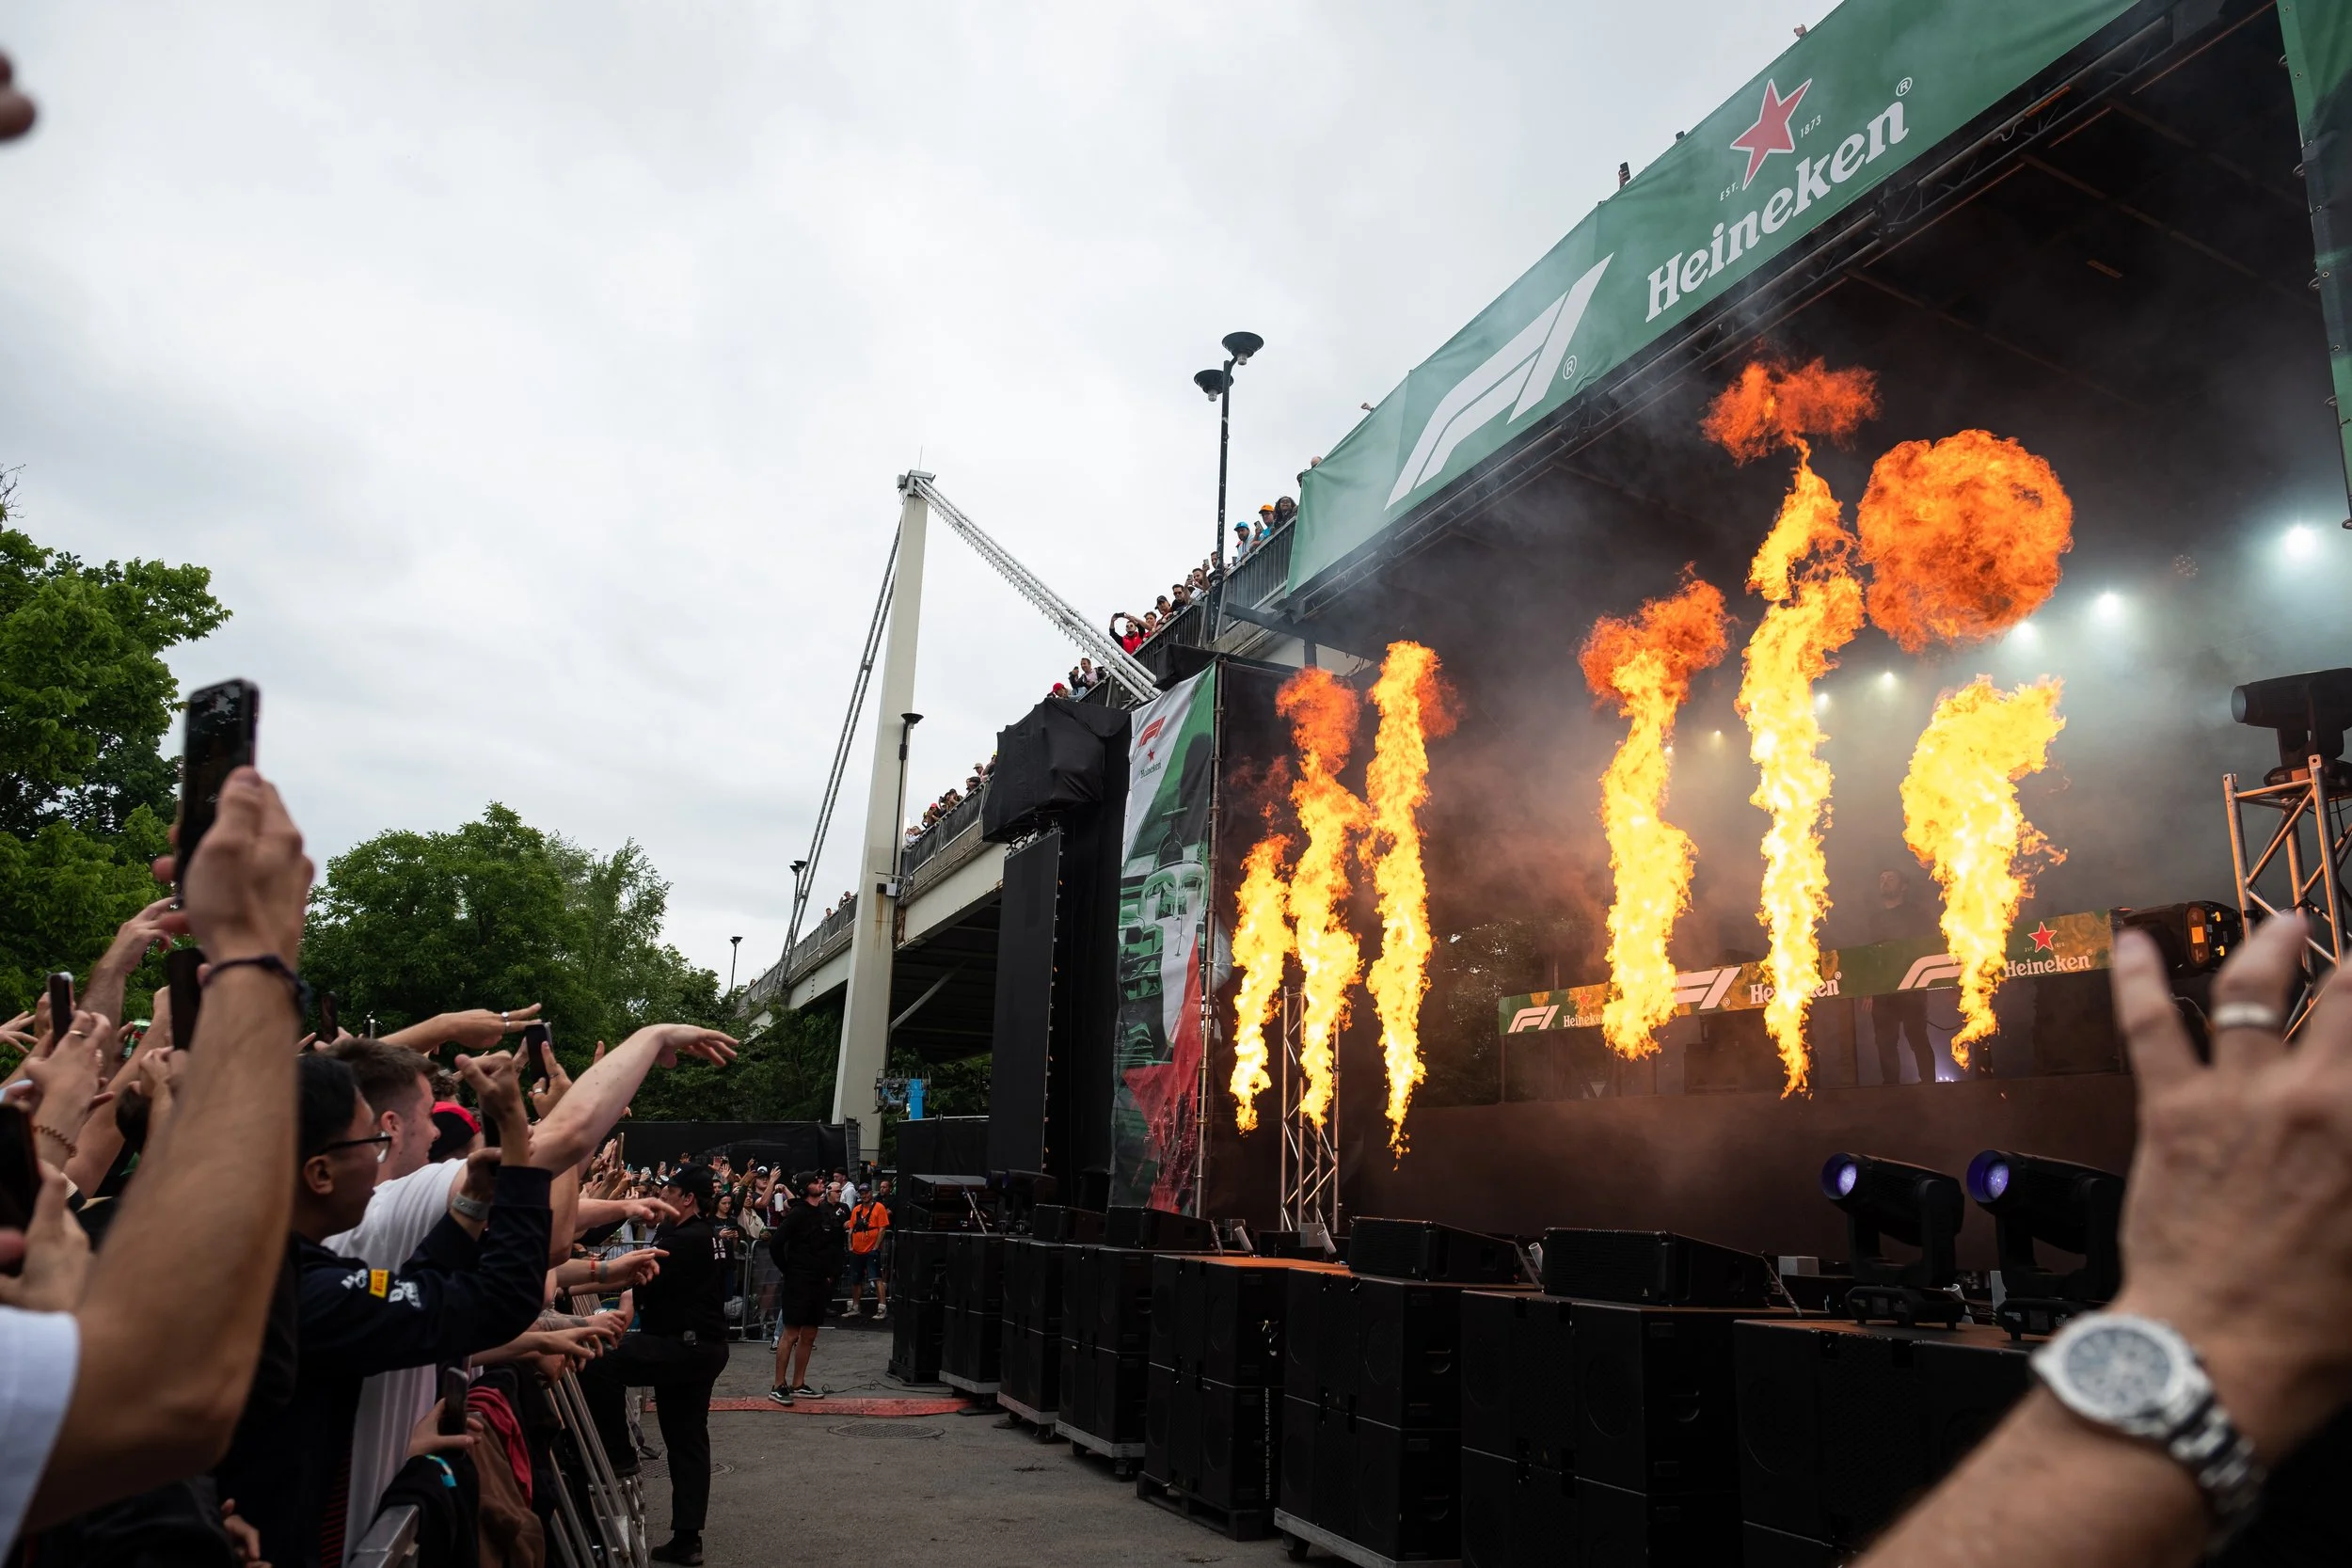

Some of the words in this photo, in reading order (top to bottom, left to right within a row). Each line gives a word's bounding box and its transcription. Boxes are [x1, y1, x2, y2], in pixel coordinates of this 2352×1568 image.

[1719, 182, 1740, 201] EST.
[1800, 114, 1822, 138] 1873
[1384, 251, 1615, 512] F1
[1645, 101, 1910, 323] Heineken
[1136, 715, 1167, 748] F1
[1140, 759, 1162, 779] Heineken
[2005, 954, 2091, 978] Heineken
[1507, 1004, 1560, 1034] F1
[1564, 1012, 1603, 1028] Heineke
